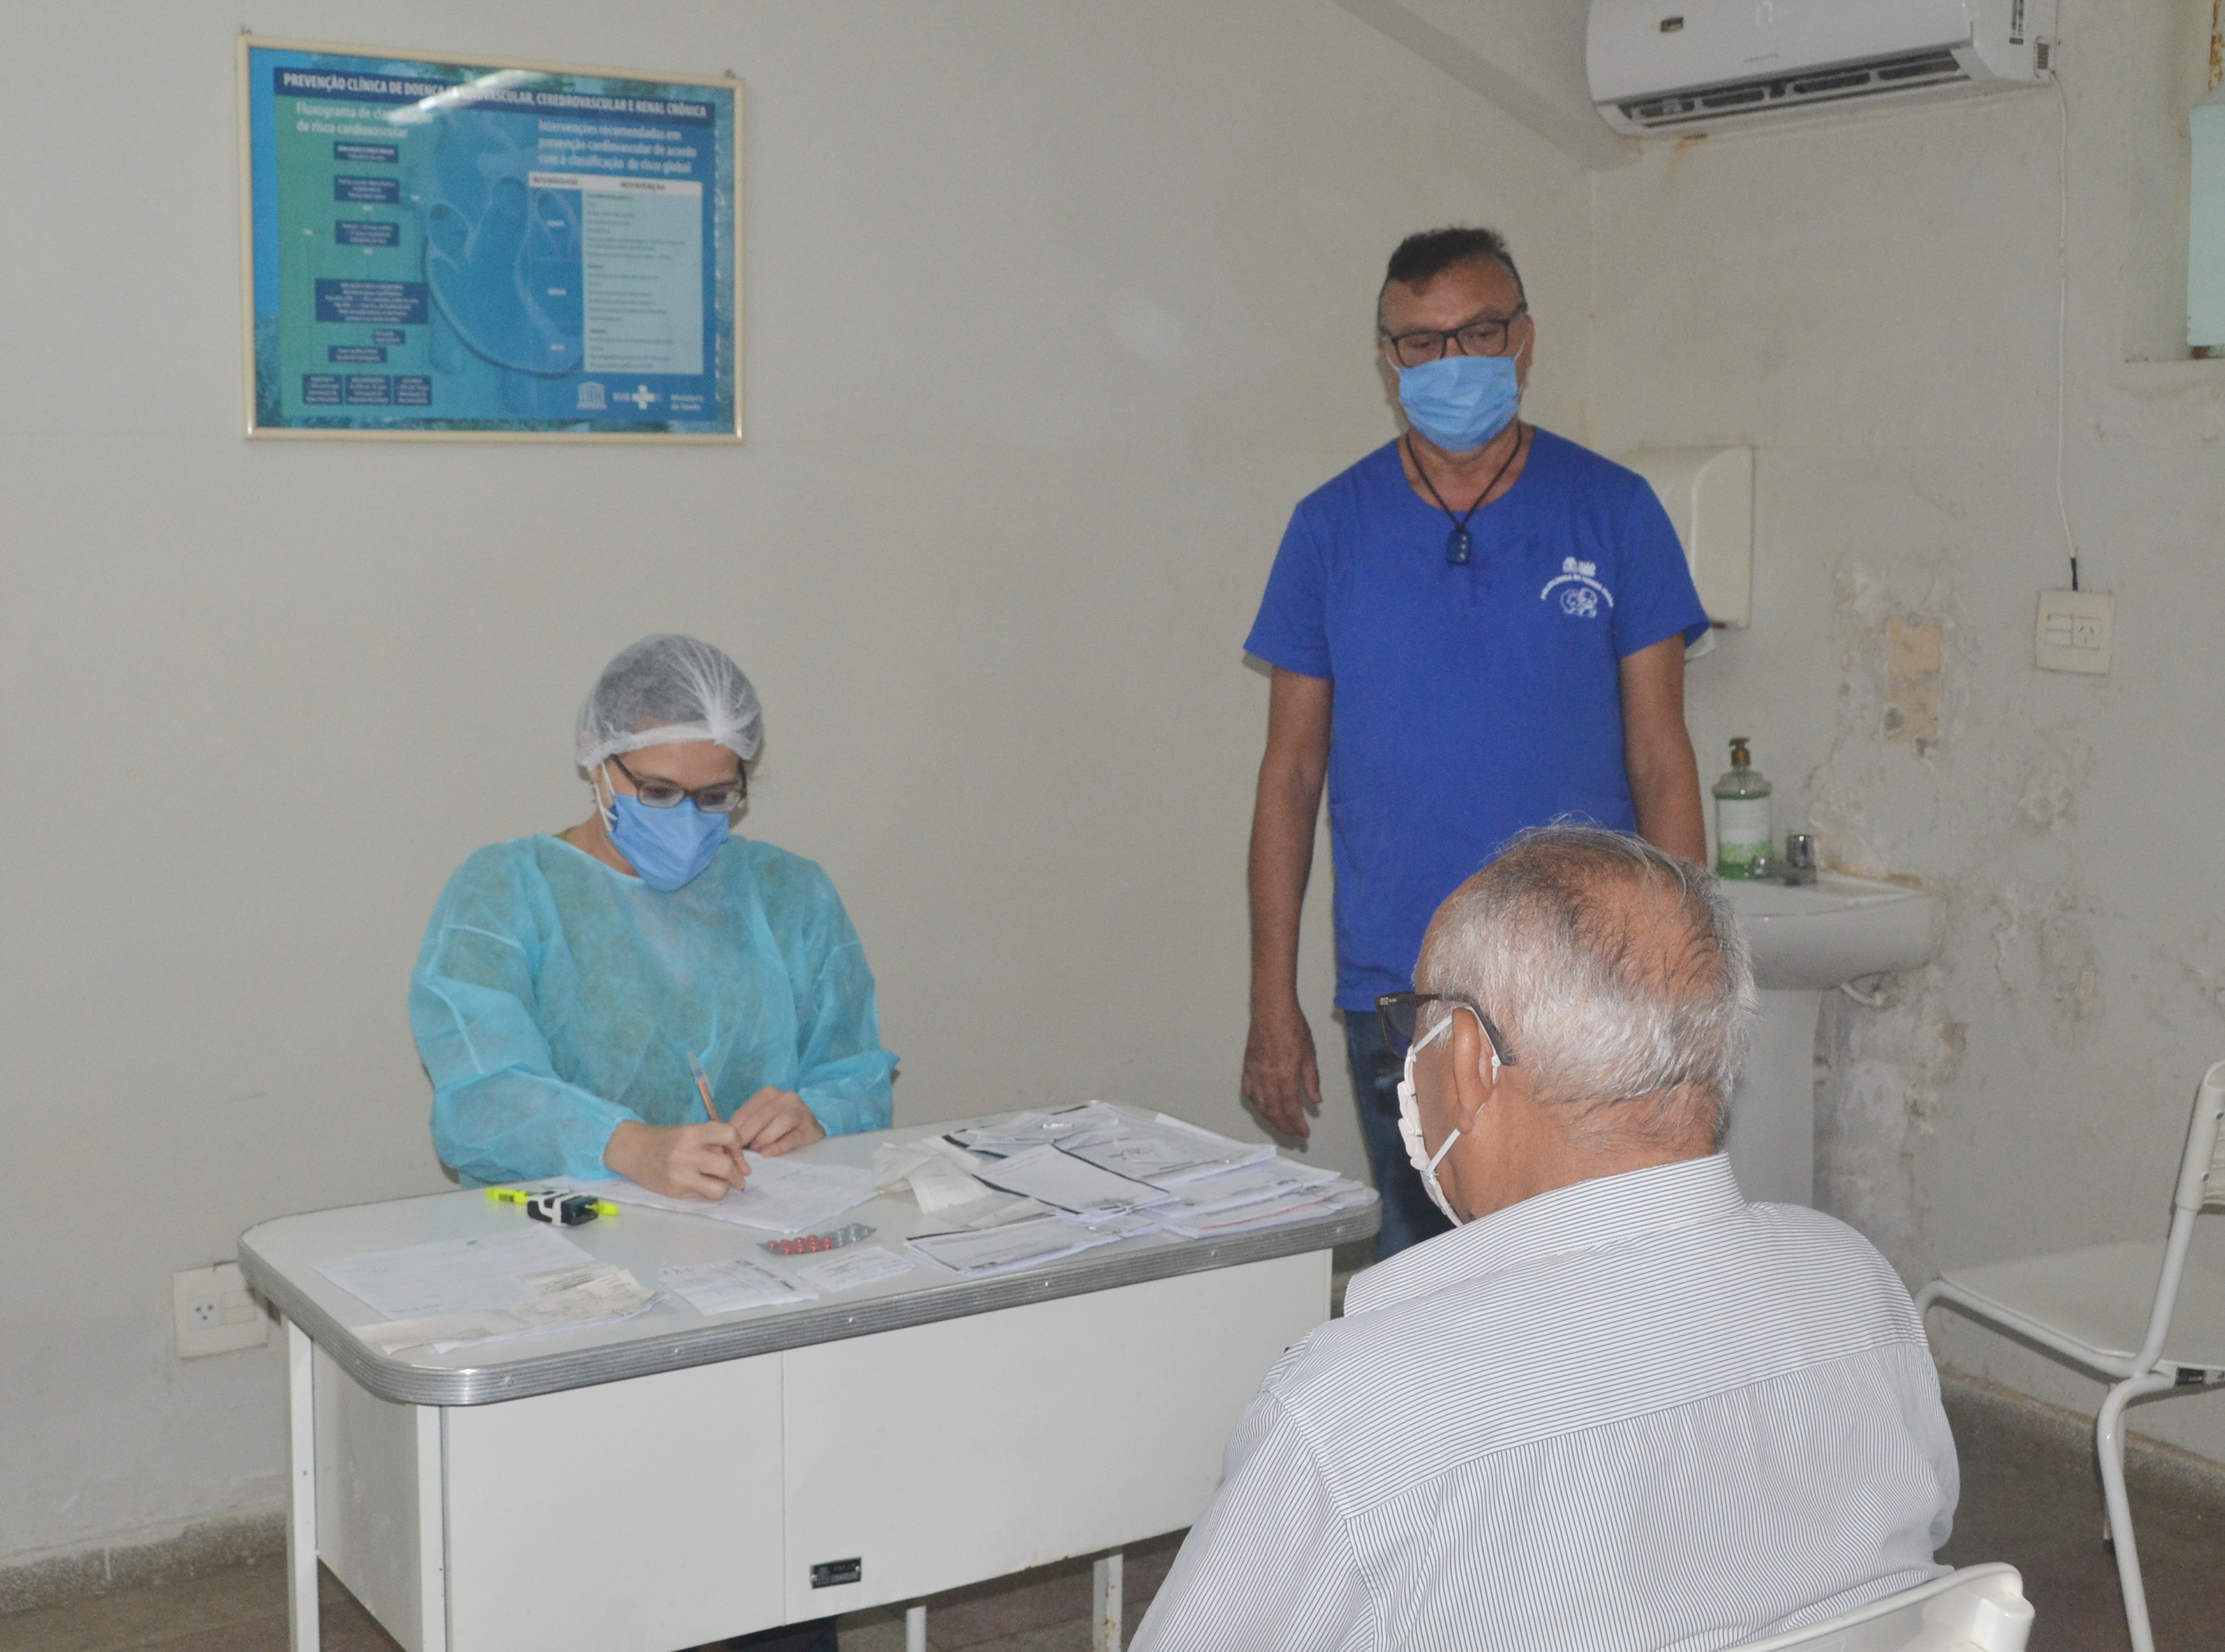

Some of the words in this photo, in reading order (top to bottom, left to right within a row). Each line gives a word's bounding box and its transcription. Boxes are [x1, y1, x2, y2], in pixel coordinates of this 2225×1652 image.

[284, 72, 346, 92] PREVENÇÃO
[347, 76, 388, 92] CLÍNICA
[389, 81, 402, 94] DE
[636, 100, 665, 115] RENAL
[666, 102, 707, 116] CRÔNICA
